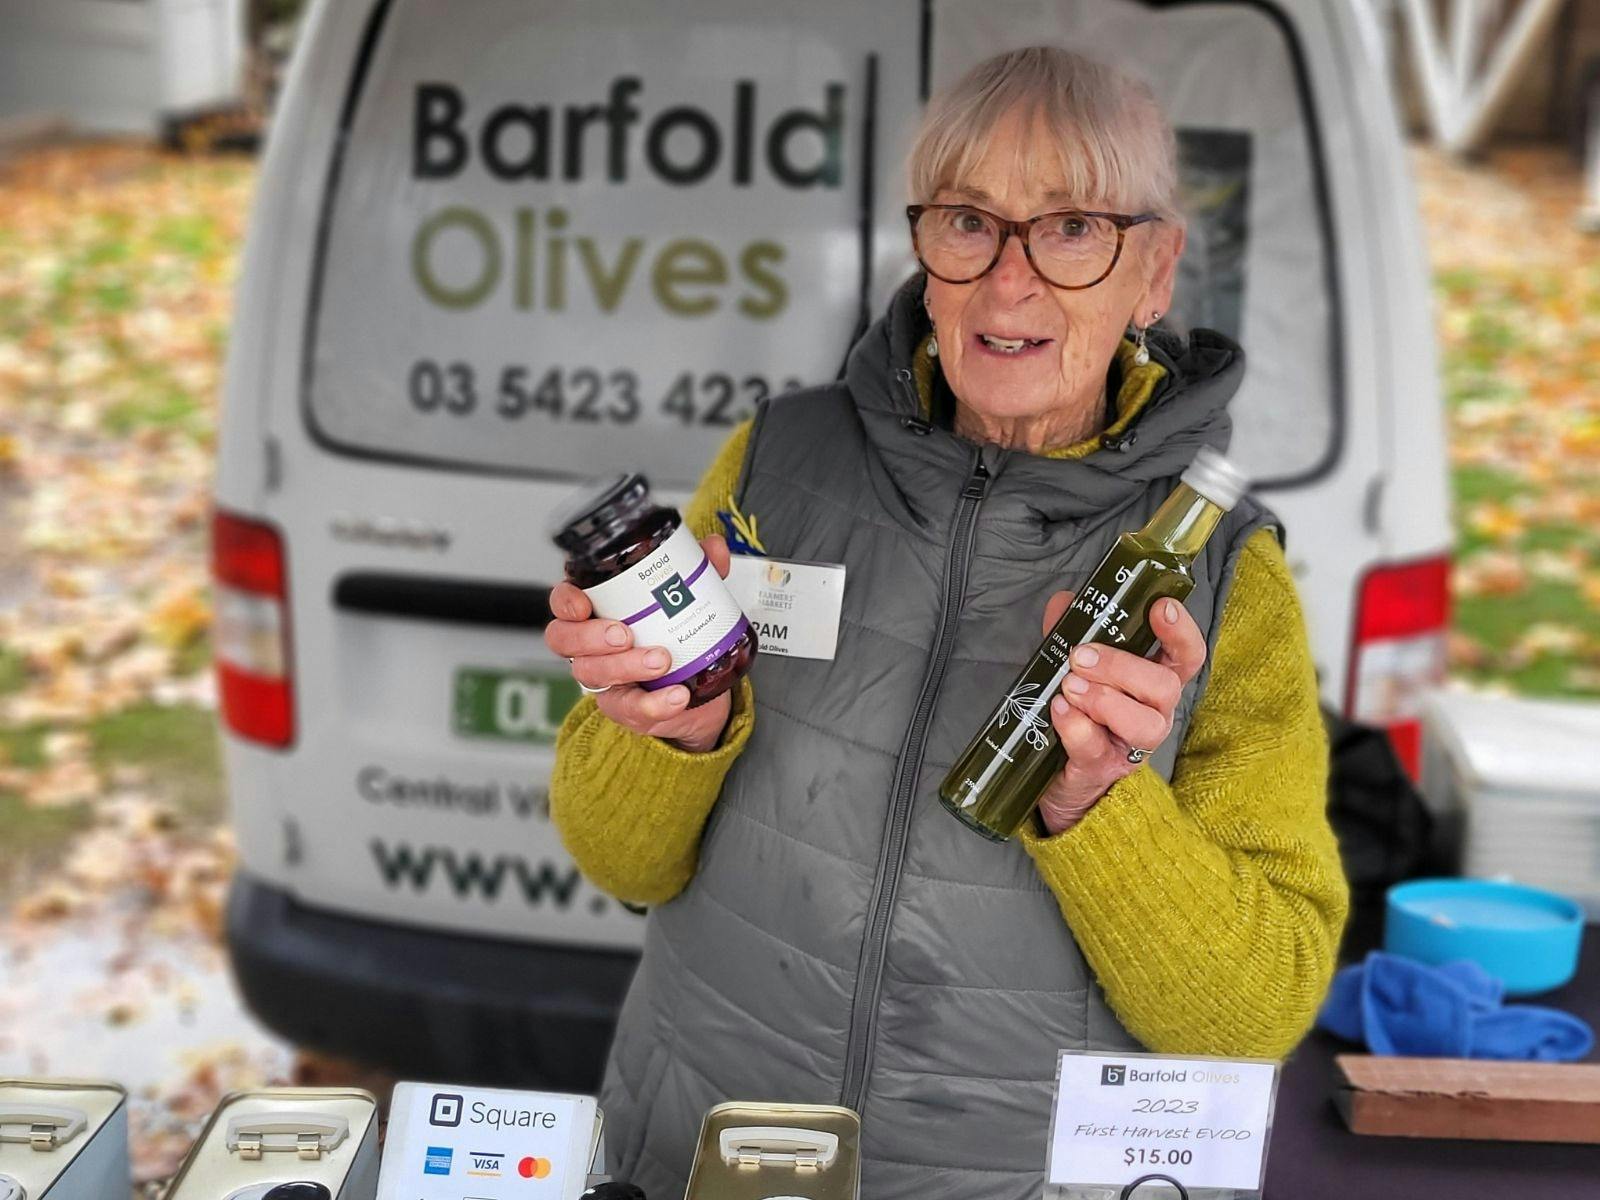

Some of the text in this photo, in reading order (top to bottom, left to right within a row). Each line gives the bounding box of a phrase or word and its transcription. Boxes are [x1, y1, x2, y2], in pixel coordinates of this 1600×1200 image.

[411, 76, 846, 188] Barfold
[411, 204, 790, 320] Olives
[409, 359, 477, 416] 03
[497, 366, 640, 425] 5423
[638, 553, 671, 580] Barfold
[1083, 586, 1129, 622] FIRST
[677, 612, 717, 644] Kalamata
[752, 621, 788, 640] PAM
[1070, 599, 1126, 643] HARVEST
[1052, 632, 1069, 650] EXTRA
[1050, 645, 1069, 662] OLIVE
[1129, 1069, 1187, 1083] Barfold
[1192, 1070, 1240, 1084] Olives
[469, 1101, 556, 1131] Square
[1132, 1098, 1200, 1114] 2023
[1073, 1122, 1251, 1141] First Harvest EVOO
[474, 1158, 499, 1170] VISA
[1123, 1147, 1193, 1166] $15.00
